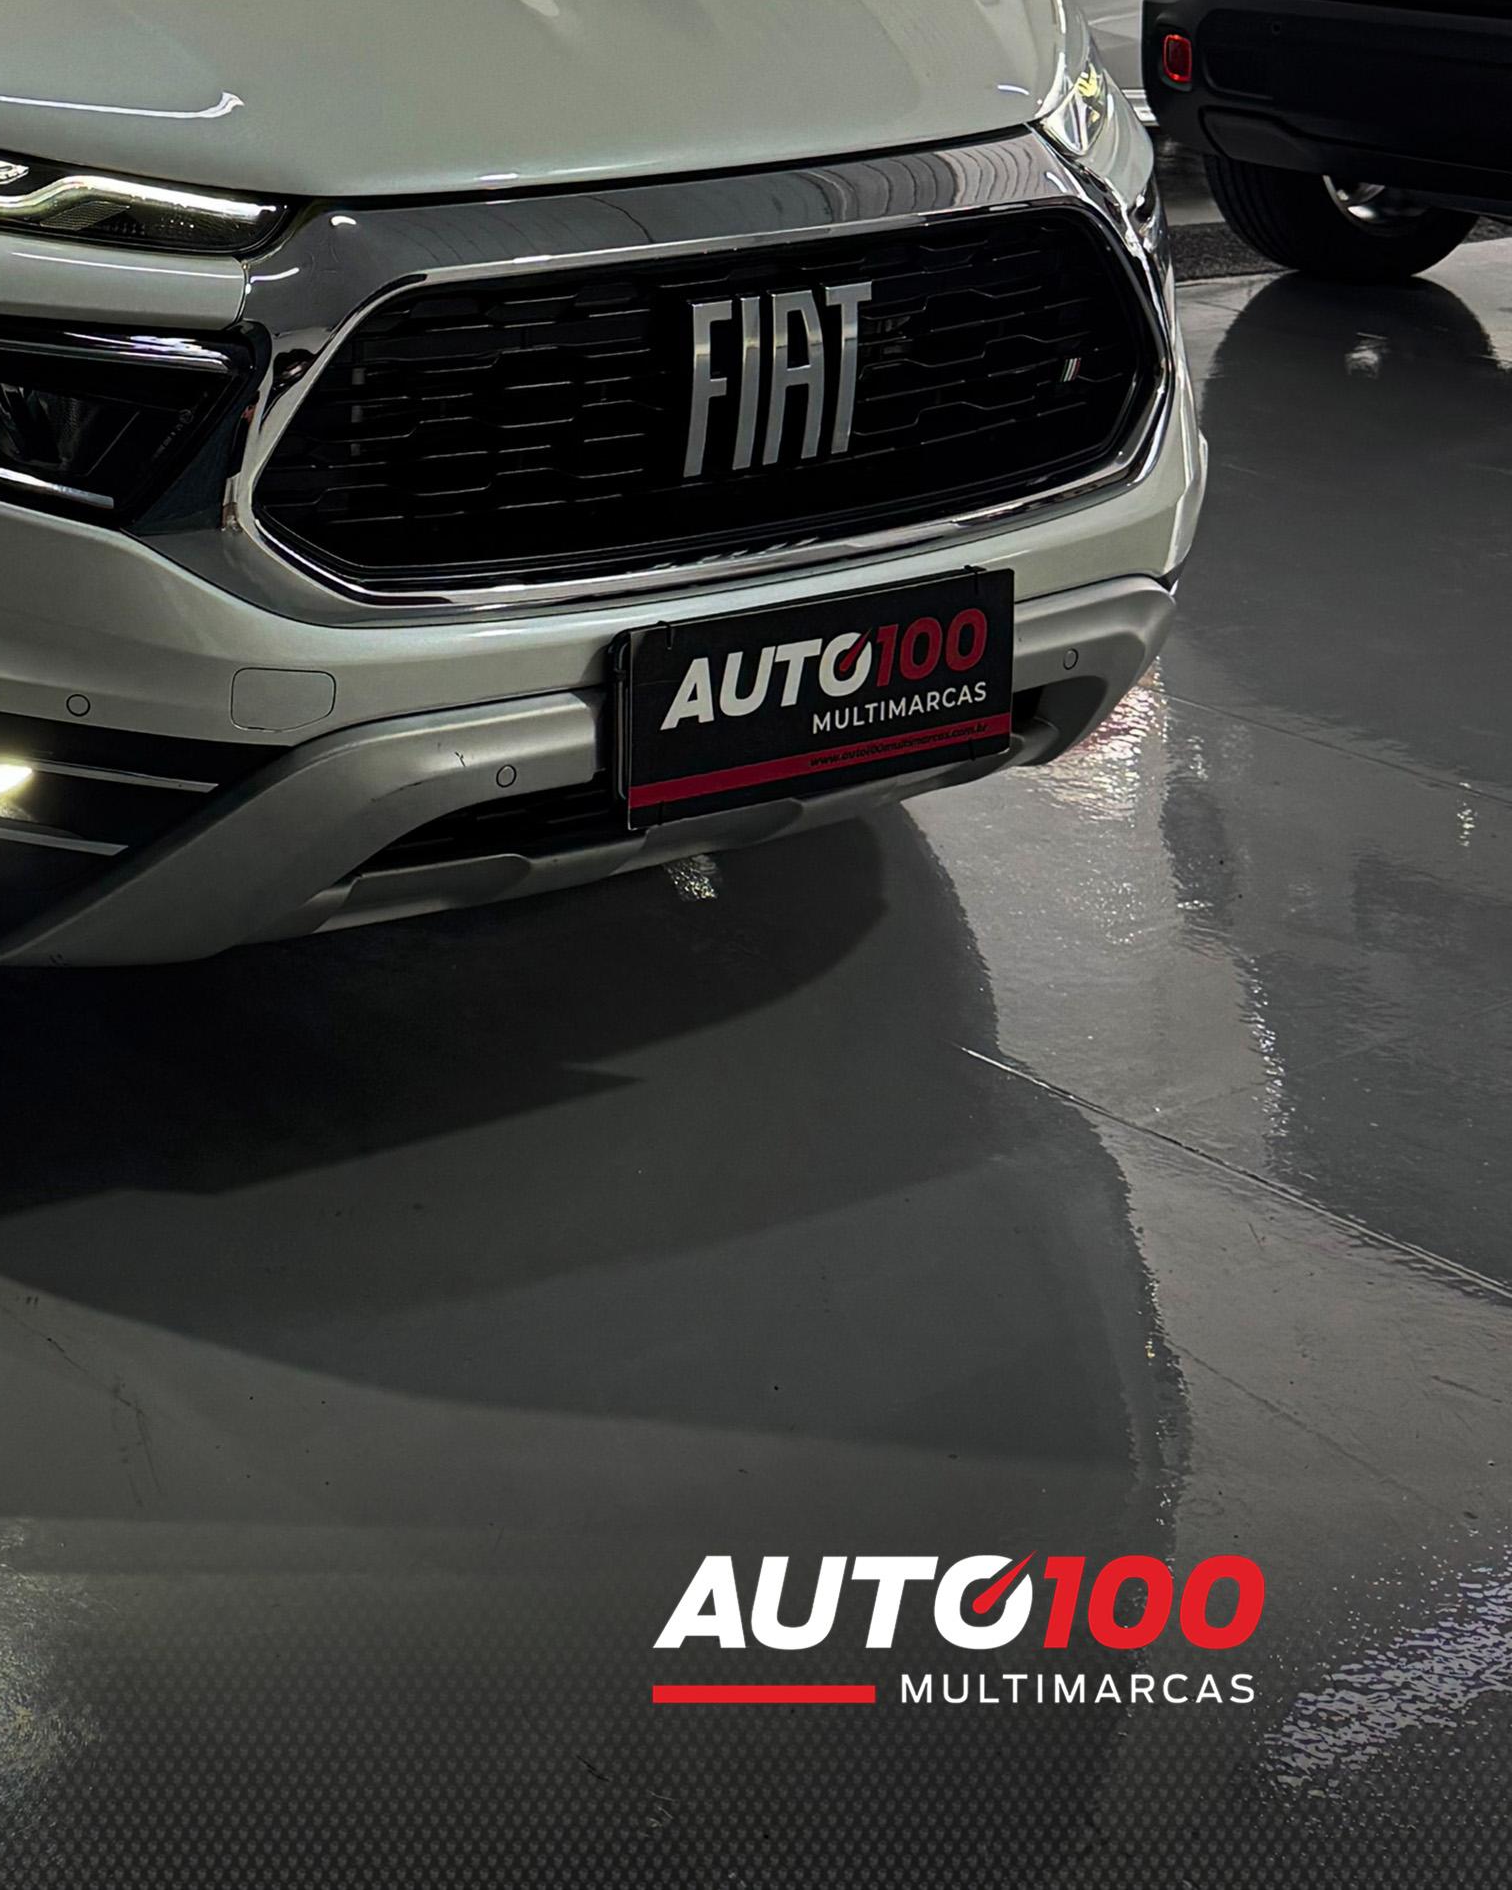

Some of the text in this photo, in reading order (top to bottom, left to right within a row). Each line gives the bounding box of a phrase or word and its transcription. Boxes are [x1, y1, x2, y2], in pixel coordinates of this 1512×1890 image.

[683, 281, 872, 477] FIAT
[660, 608, 988, 730] AUTO100
[812, 681, 988, 734] MULTIMARCAS
